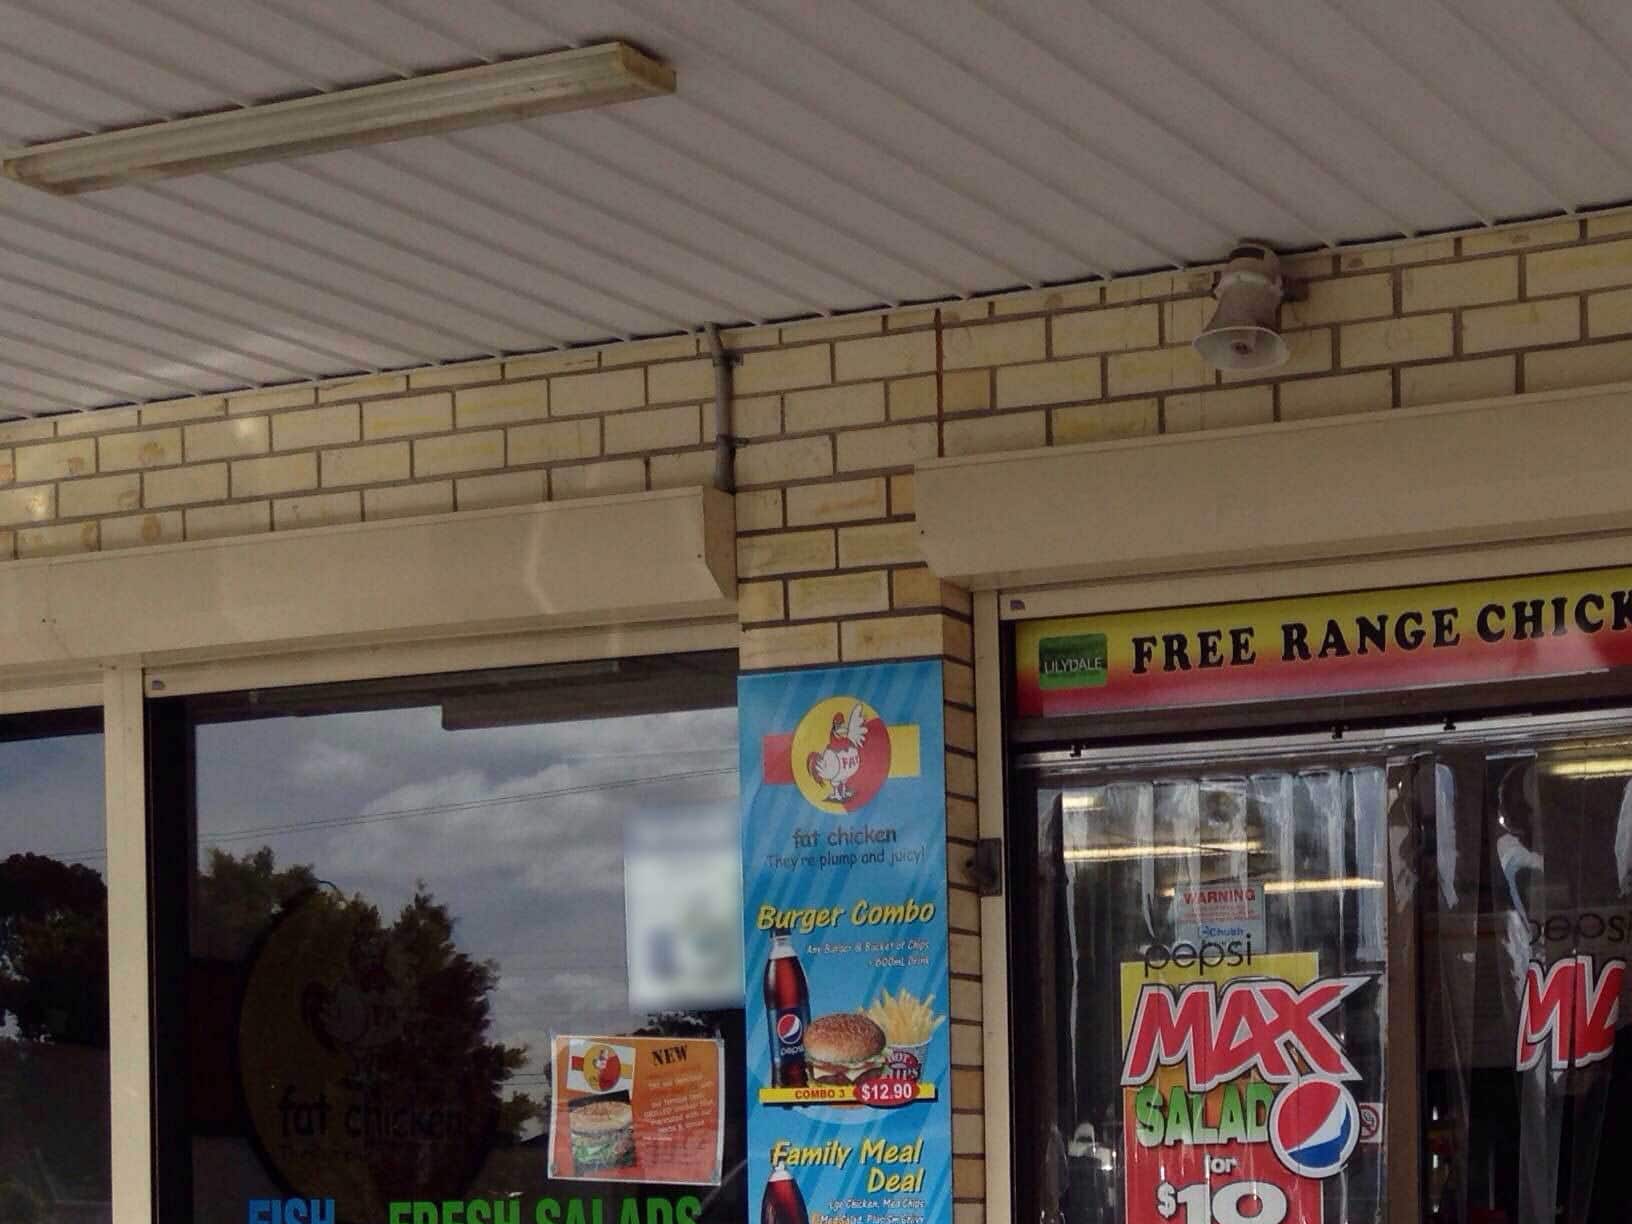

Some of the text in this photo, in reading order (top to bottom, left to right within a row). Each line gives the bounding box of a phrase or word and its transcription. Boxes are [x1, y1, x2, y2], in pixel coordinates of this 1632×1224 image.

[1131, 626, 1257, 674] FREE
[1281, 607, 1460, 662] RANGE
[1044, 657, 1103, 674] LILYDALE
[792, 826, 896, 848] fat chicken
[766, 854, 815, 870] They're
[820, 851, 857, 869] plump
[862, 850, 884, 863] and
[1184, 888, 1256, 904] WARNING
[758, 898, 935, 933] Burger Combo
[1142, 934, 1252, 978] pepsi
[1120, 972, 1384, 1093] MAX
[652, 1045, 687, 1065] NEW
[781, 1046, 803, 1056] peps
[795, 1089, 835, 1099] COMBO
[862, 1083, 912, 1100] $12.90
[279, 1084, 333, 1138] fat
[1134, 1082, 1275, 1148] SALAD
[771, 1137, 925, 1169] Family Meal
[867, 1167, 926, 1193] Deal
